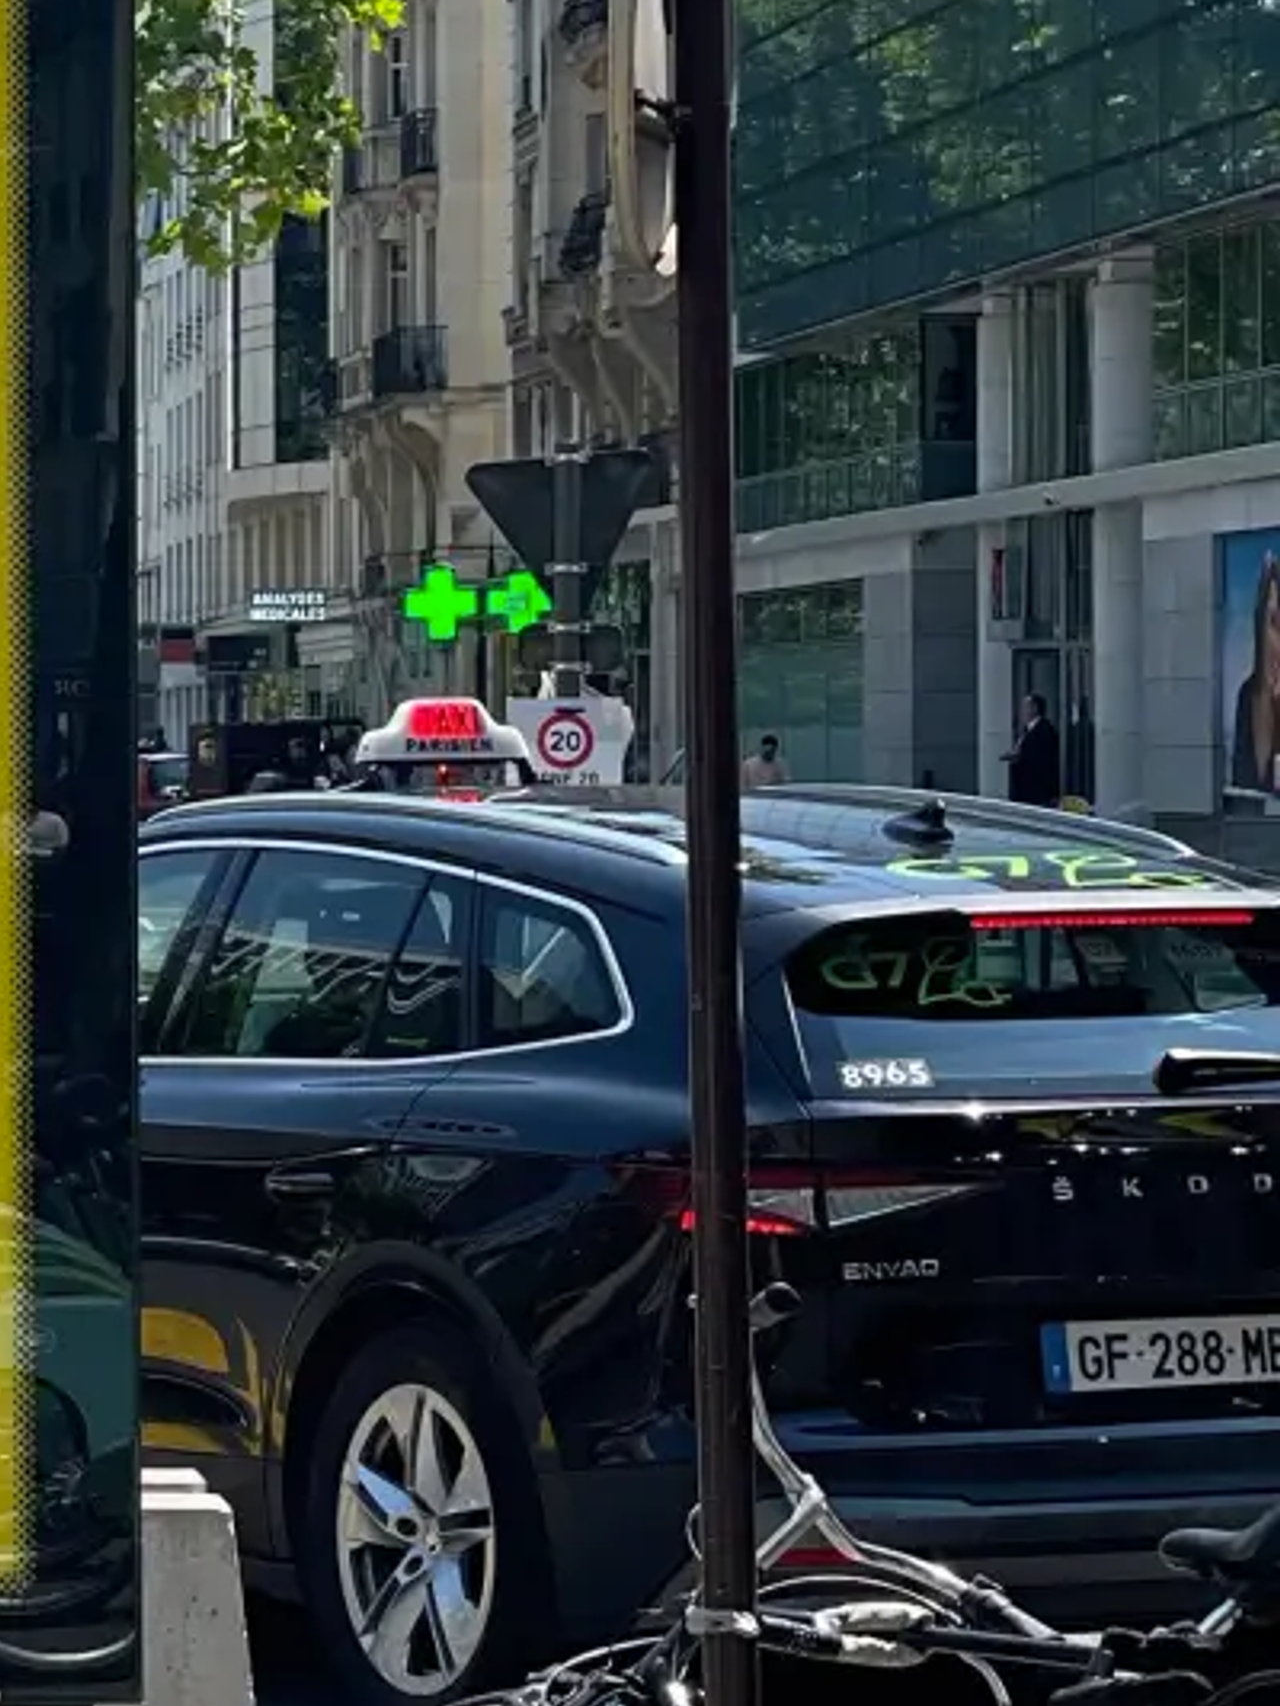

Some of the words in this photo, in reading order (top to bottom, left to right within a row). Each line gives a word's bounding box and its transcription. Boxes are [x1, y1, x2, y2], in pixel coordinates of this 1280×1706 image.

[416, 704, 480, 736] TAXI
[406, 738, 494, 752] PARISIEN
[550, 731, 581, 753] 20
[820, 951, 909, 989] G7
[841, 1061, 931, 1088] 8965
[1052, 1173, 1274, 1201] ŠKOD
